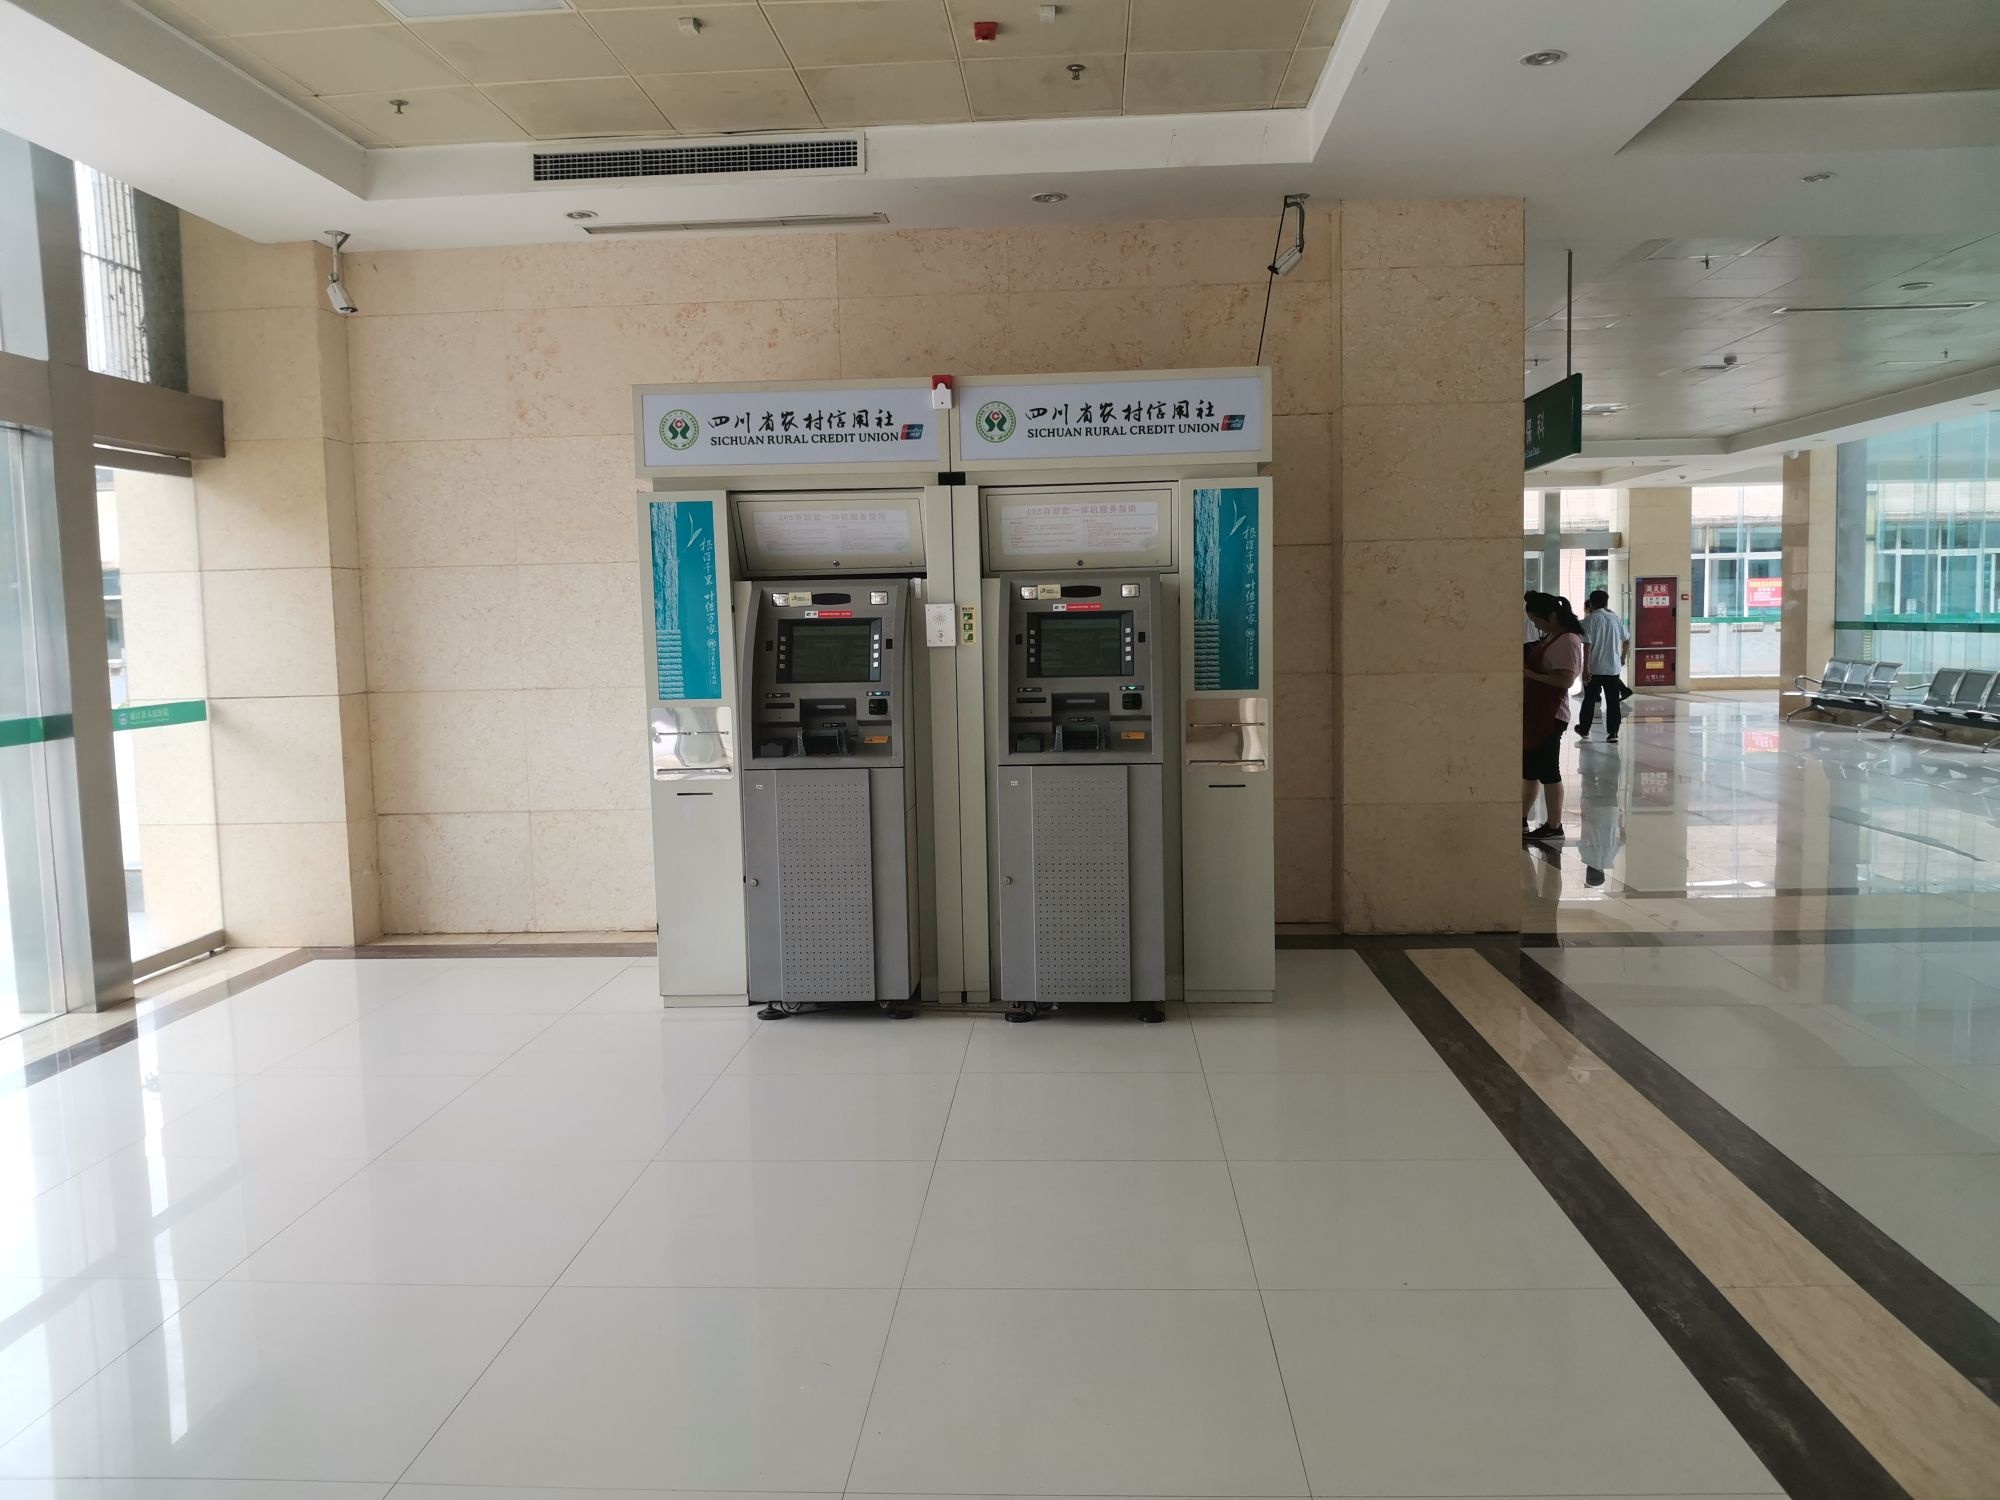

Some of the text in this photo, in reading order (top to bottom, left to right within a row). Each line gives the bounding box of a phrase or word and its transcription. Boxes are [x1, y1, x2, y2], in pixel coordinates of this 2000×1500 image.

[708, 409, 894, 433] 四川省农村信用社
[1025, 400, 1215, 424] 四川省农村信用社
[710, 431, 899, 446] SICHUAN RURAL CREDIT UNION
[1027, 422, 1220, 438] SICHUAN RURAL CREDIT UNION
